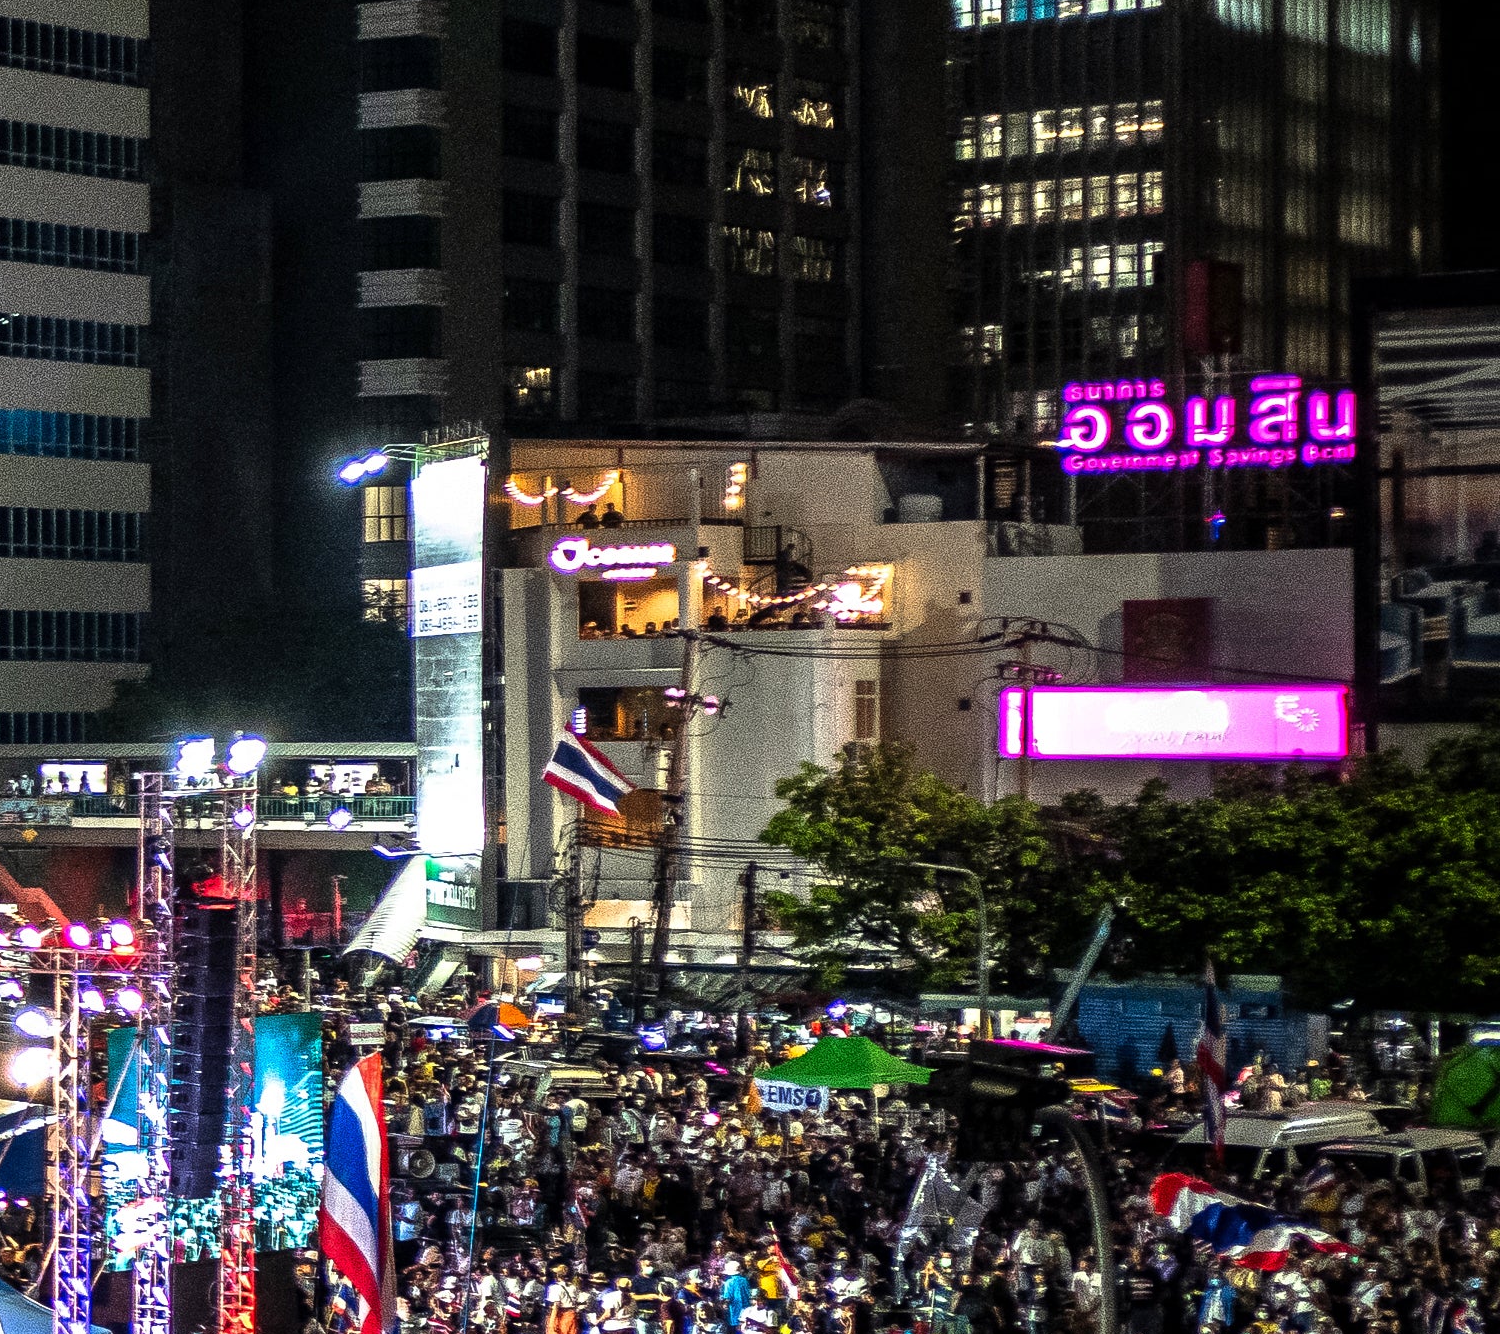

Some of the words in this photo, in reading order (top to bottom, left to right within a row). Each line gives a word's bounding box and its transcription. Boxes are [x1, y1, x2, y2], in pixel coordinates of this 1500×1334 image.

[1063, 374, 1356, 453] ออมสิน
[1064, 450, 1201, 475] Government
[1207, 446, 1297, 469] Savings
[768, 1085, 804, 1106] EMS
